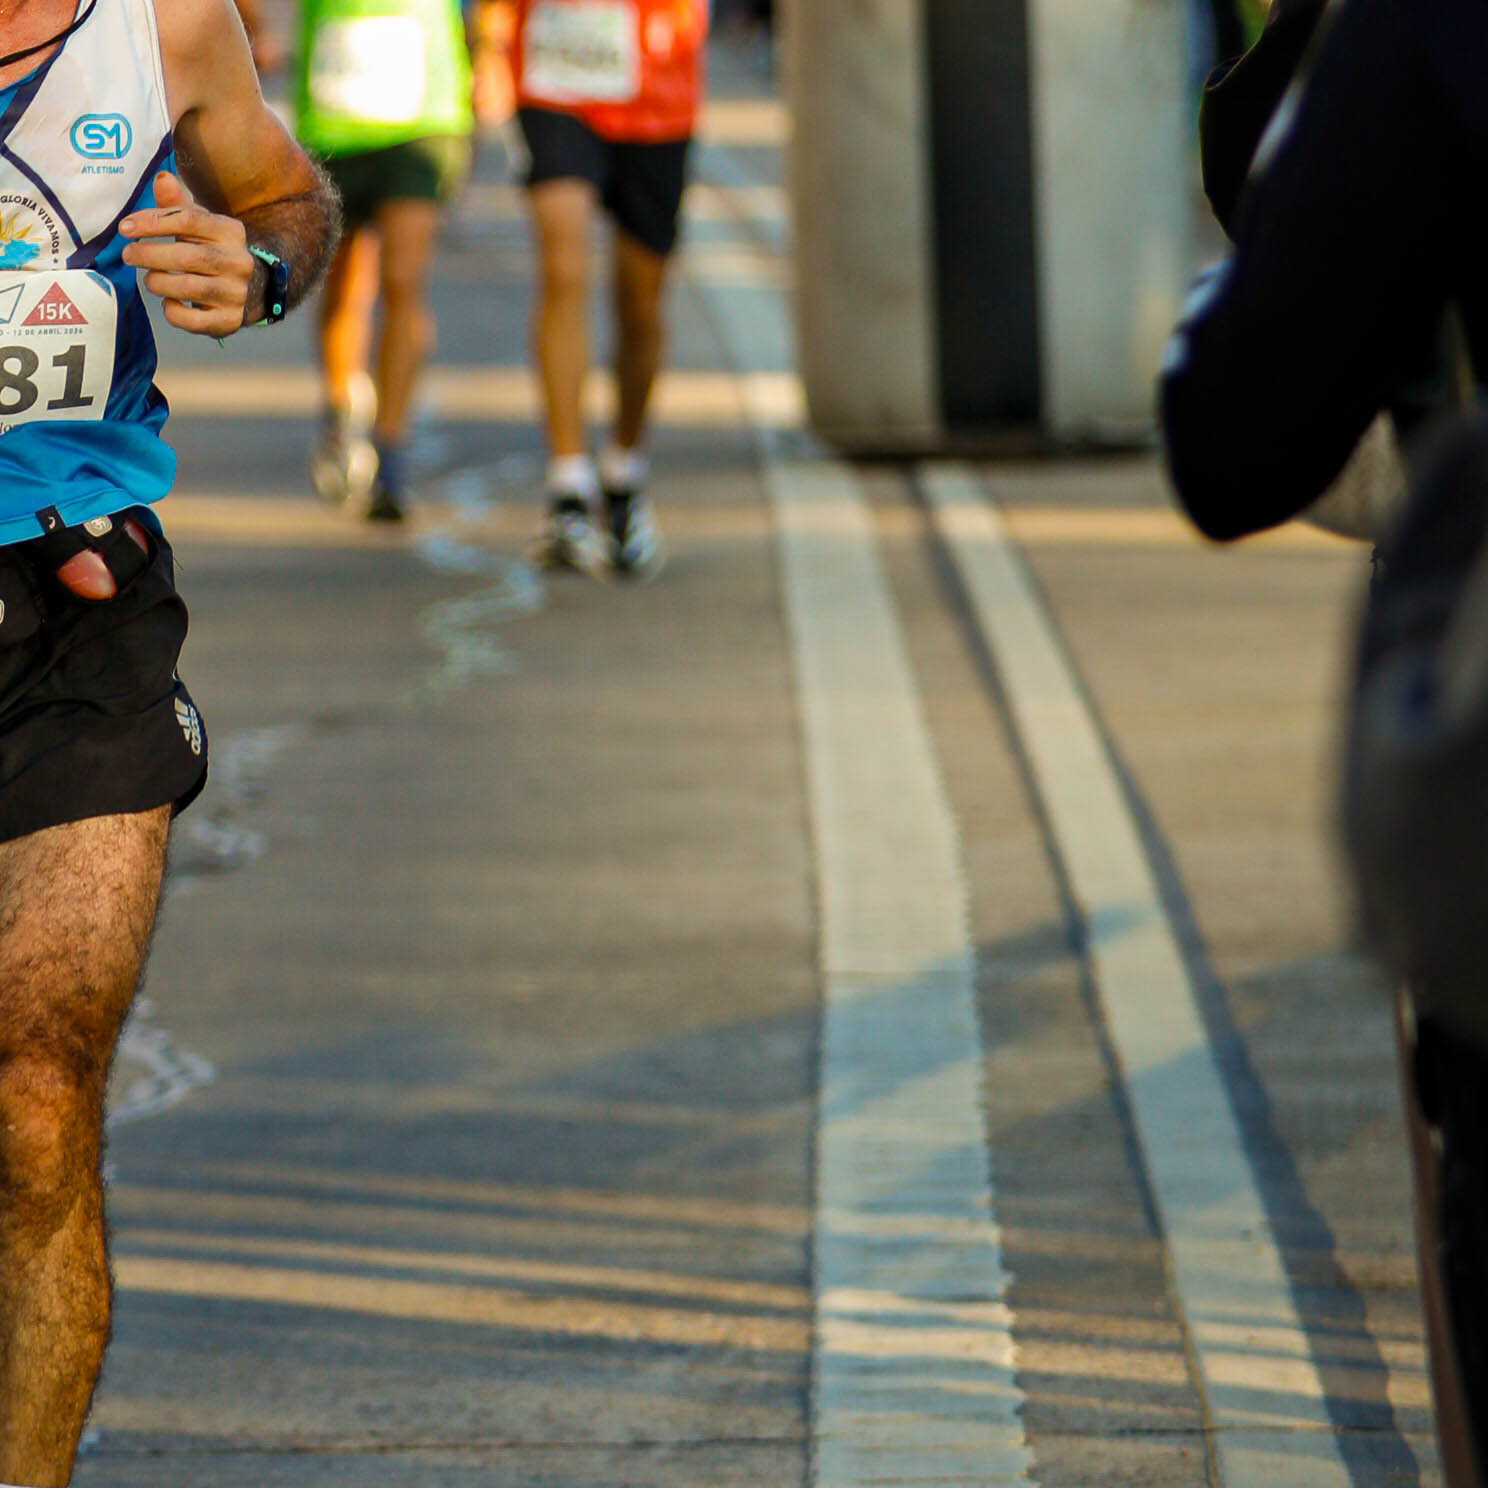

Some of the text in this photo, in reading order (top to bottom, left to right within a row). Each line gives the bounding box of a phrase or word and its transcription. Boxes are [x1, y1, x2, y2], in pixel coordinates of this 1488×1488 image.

[81, 165, 125, 174] ATLETISMO
[0, 195, 37, 211] GLORIA
[38, 208, 60, 254] VIVAMOS
[37, 302, 73, 321] 15K
[38, 328, 61, 336] ABRIL
